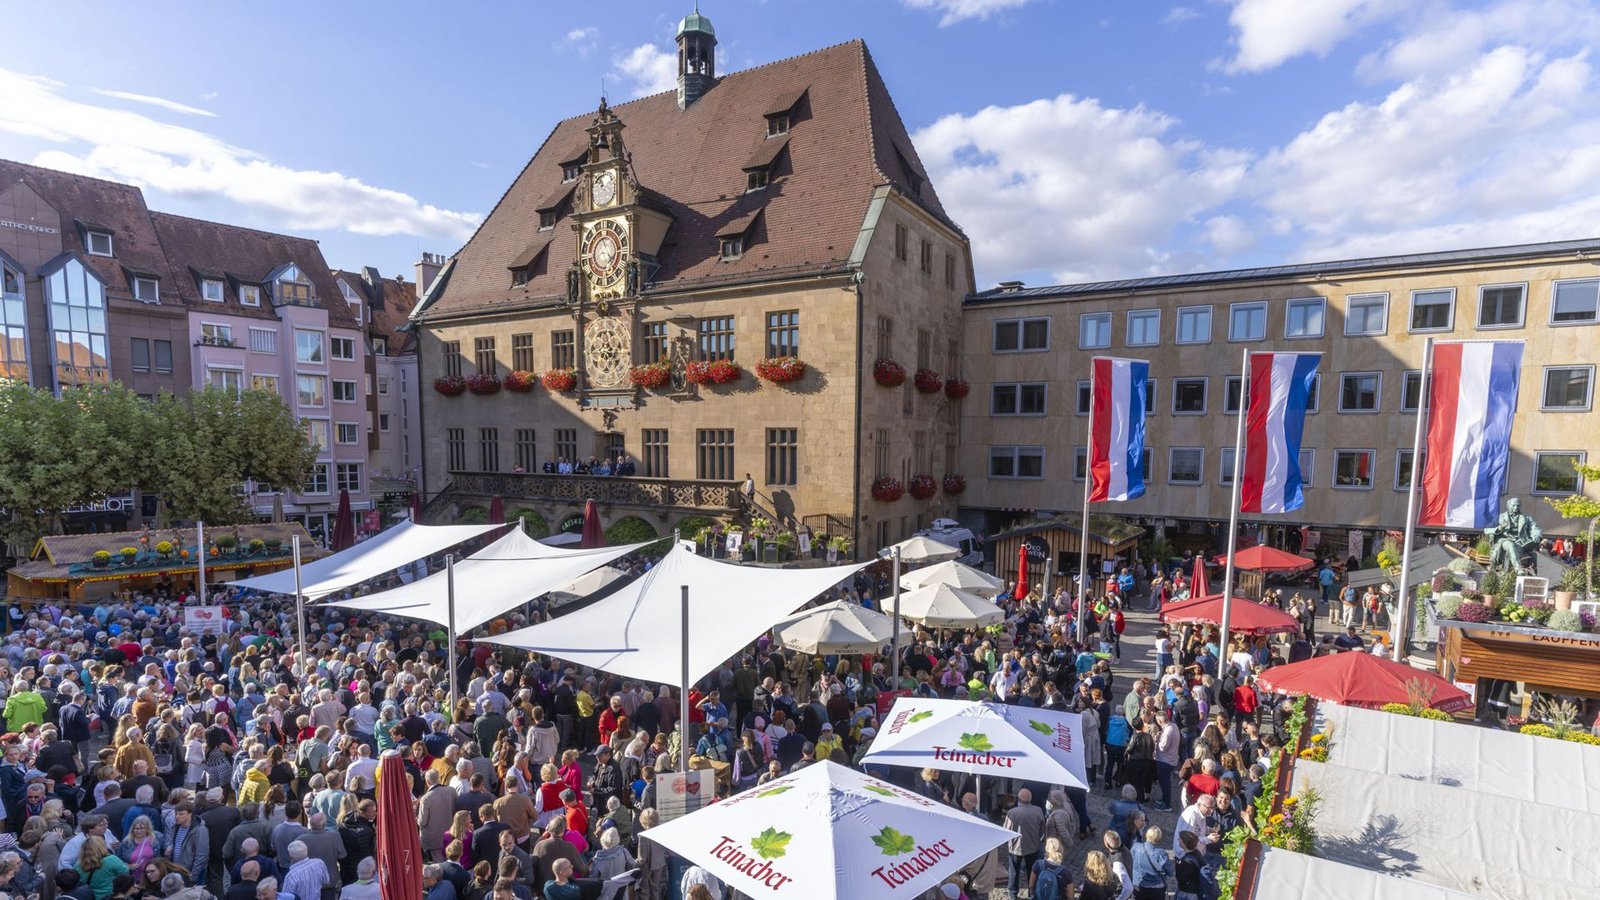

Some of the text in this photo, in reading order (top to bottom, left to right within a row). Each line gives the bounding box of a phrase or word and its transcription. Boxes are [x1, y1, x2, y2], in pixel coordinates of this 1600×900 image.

[931, 746, 1016, 768] Teinacher
[709, 836, 793, 890] Teinacher
[871, 839, 955, 889] Teinacher
